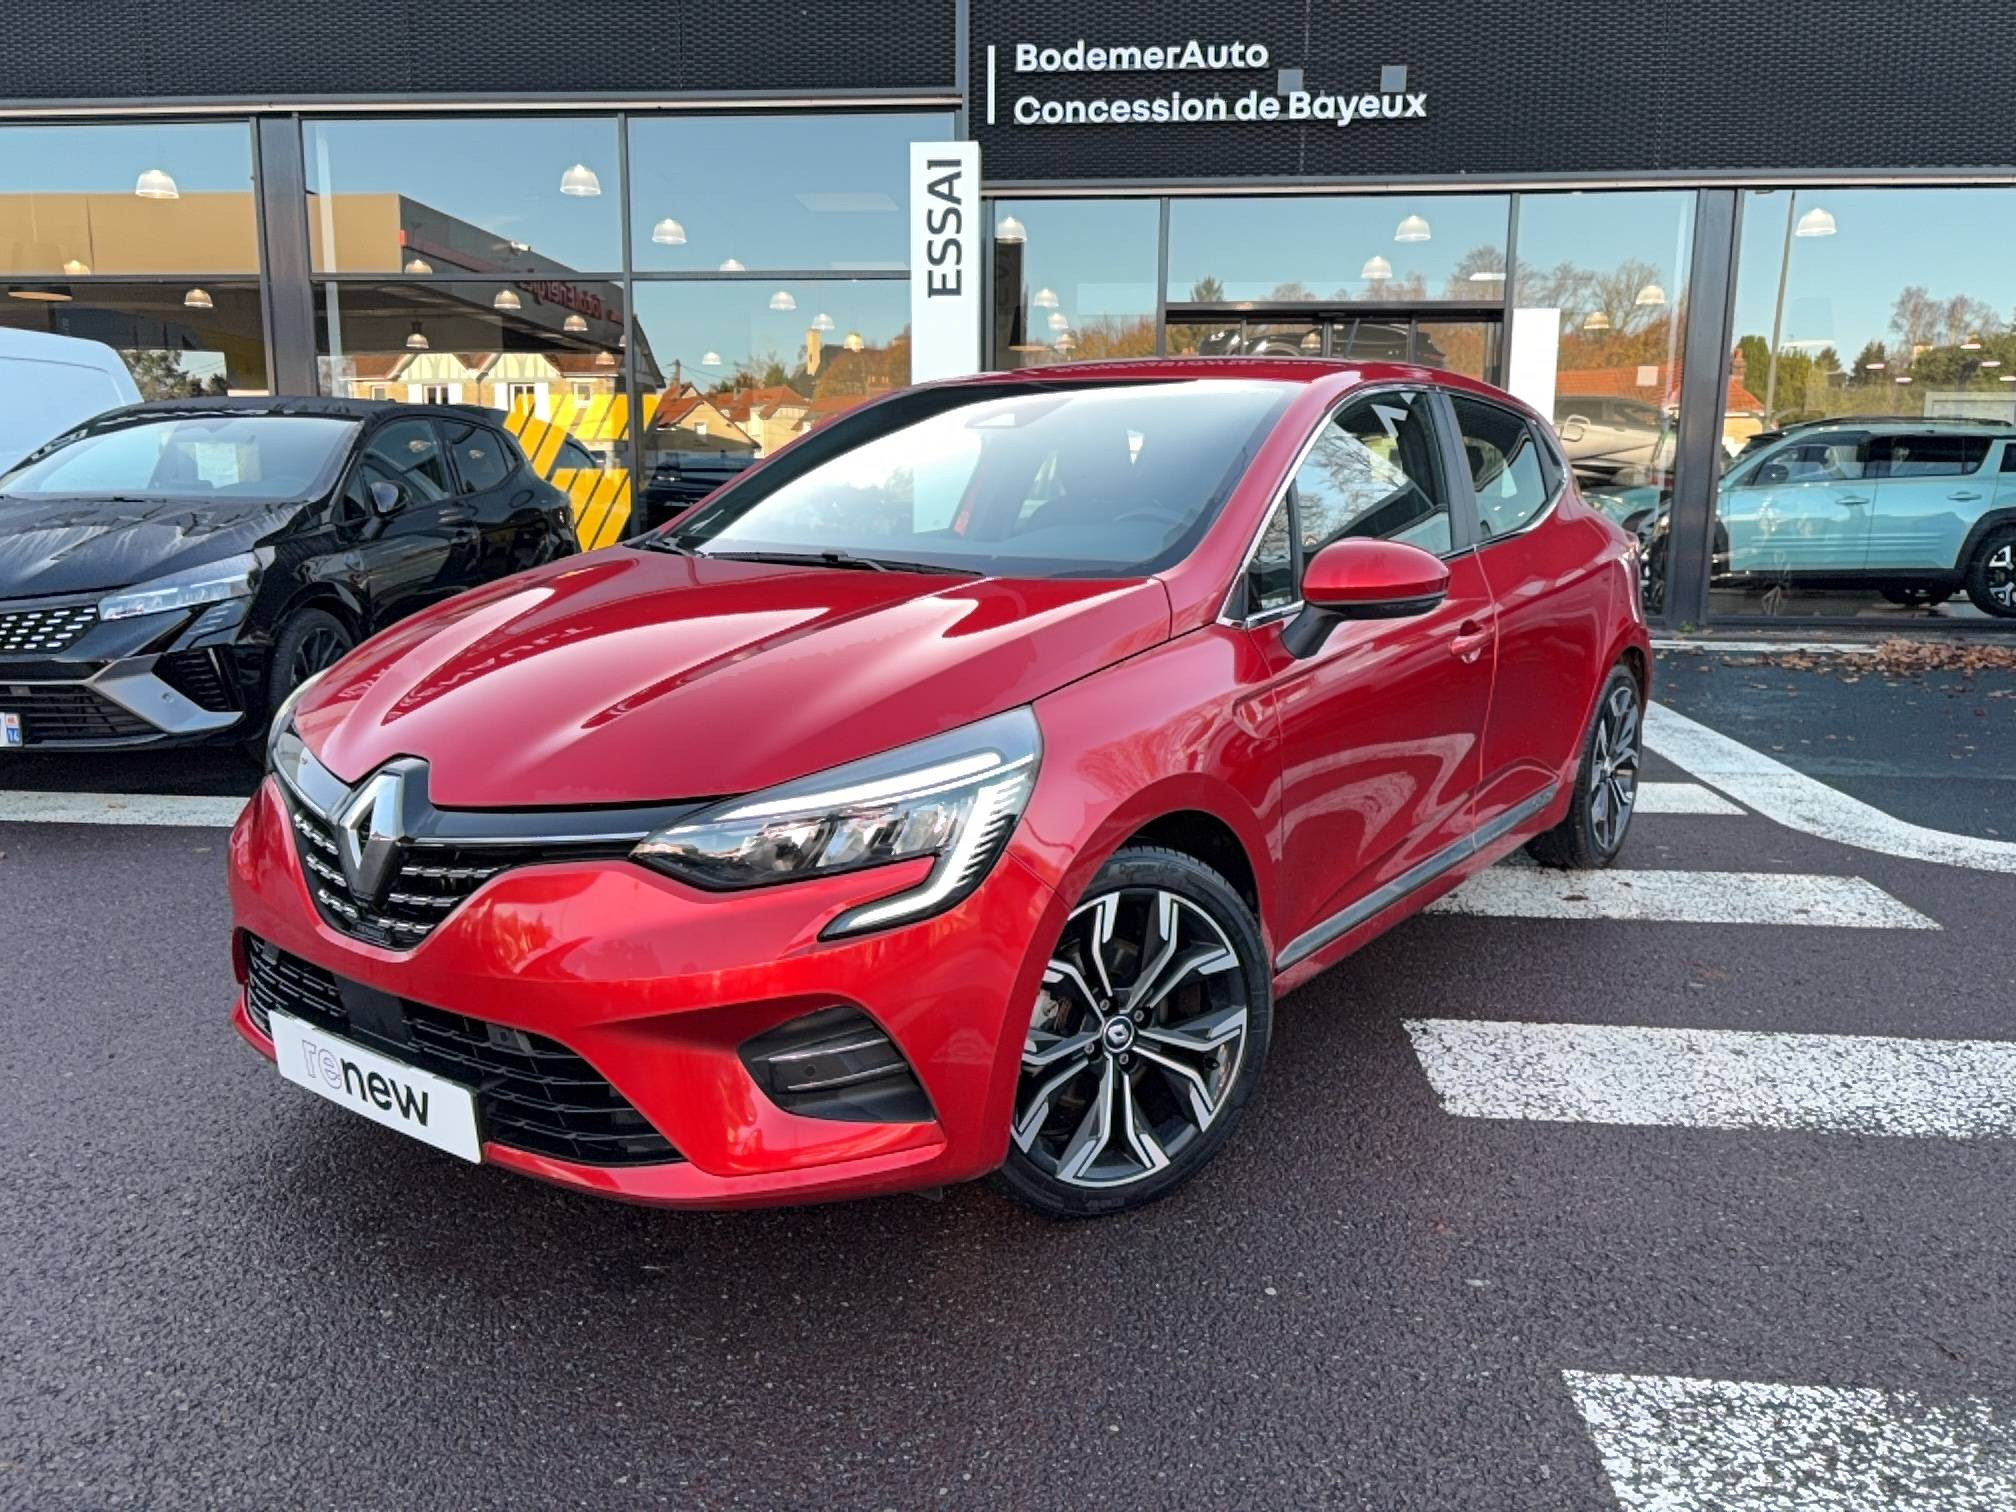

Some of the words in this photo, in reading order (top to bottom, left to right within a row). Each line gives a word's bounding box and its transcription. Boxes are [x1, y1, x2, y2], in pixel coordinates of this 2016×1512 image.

[1015, 40, 1269, 72] BodemerAuto
[1014, 91, 1228, 125] Concession
[1234, 90, 1280, 120] de
[1288, 91, 1428, 127] Bayeux
[927, 159, 962, 298] ESSAI
[302, 1039, 428, 1127] renew
